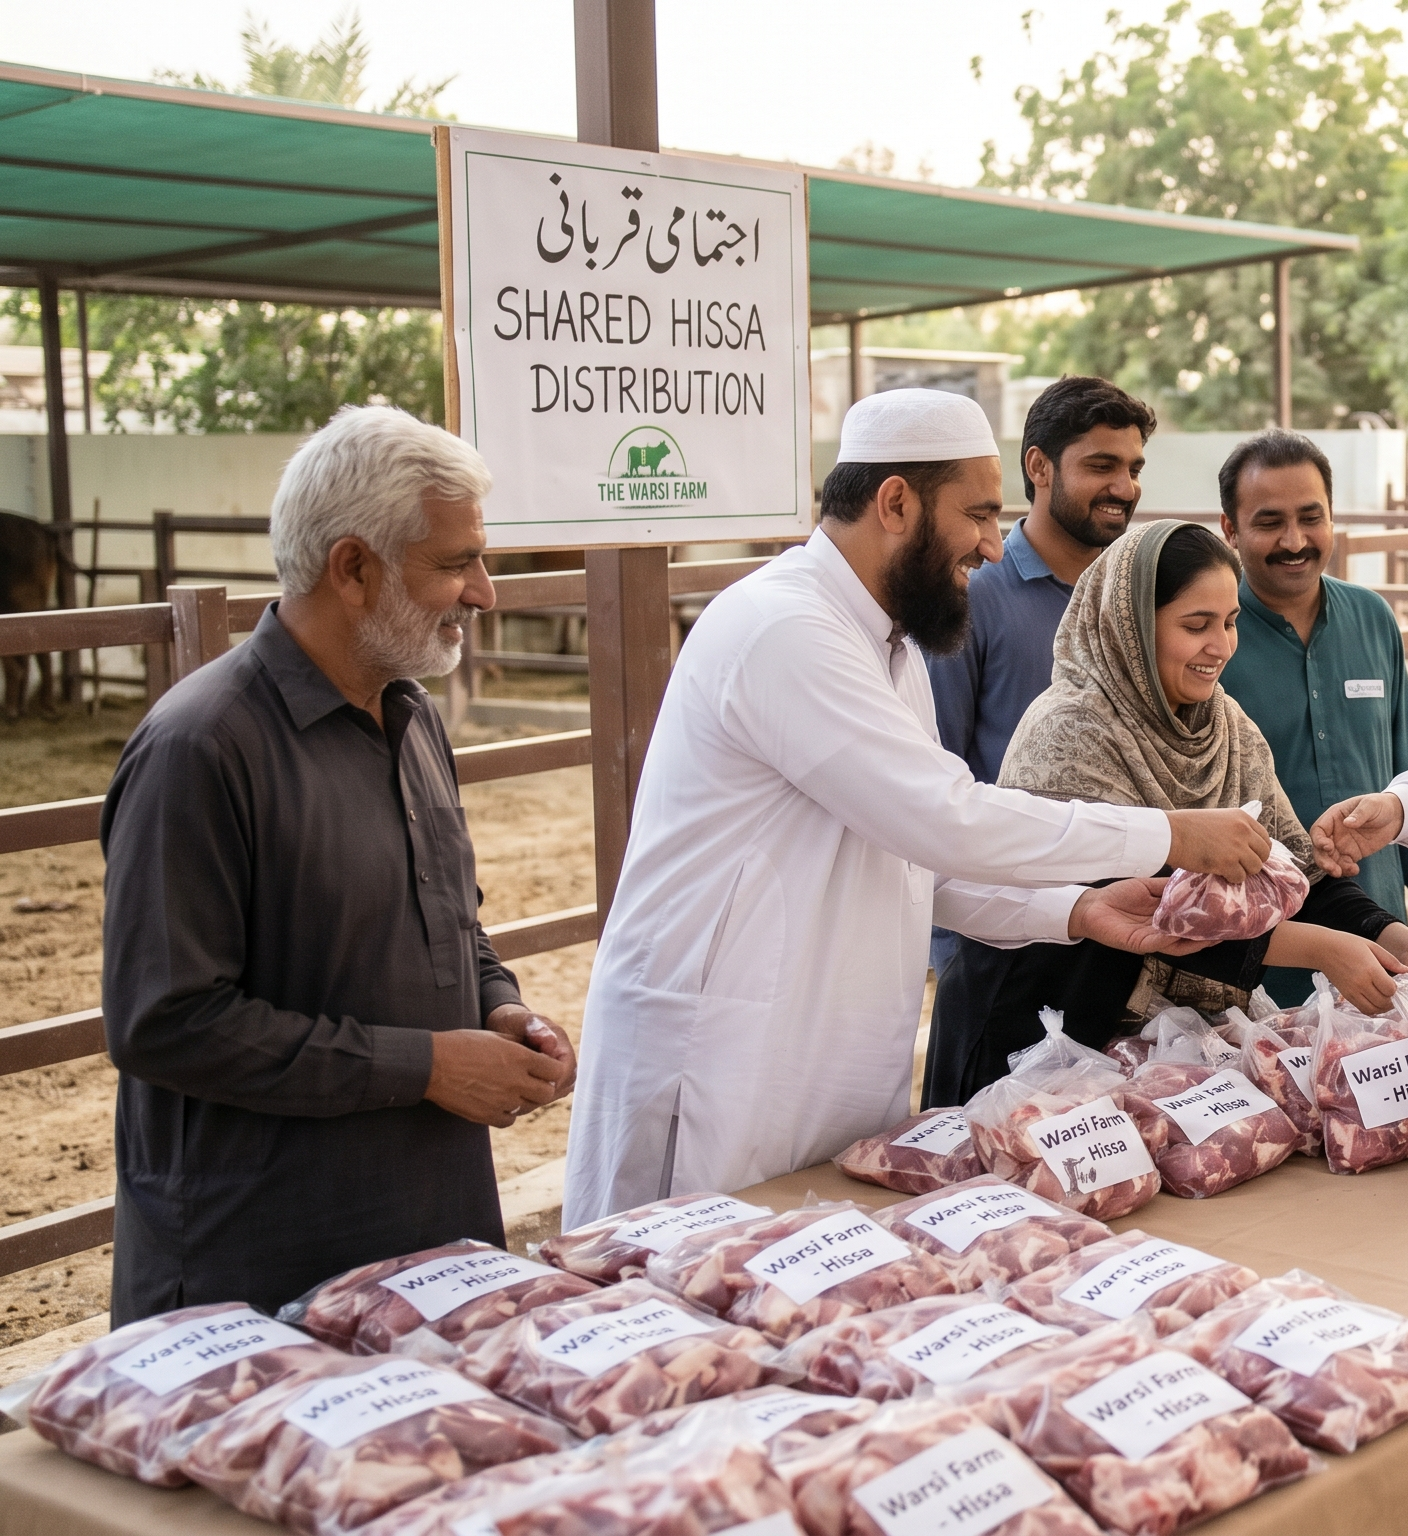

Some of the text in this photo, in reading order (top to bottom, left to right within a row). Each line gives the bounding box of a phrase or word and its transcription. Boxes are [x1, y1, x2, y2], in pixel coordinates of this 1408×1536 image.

[537, 172, 643, 271] قربانی
[494, 285, 766, 351] SHARED HISSA
[530, 363, 764, 416] DISTRIBUTION
[598, 481, 708, 501] THE WARSI FARM
[1352, 1057, 1402, 1085] Warsi
[1039, 1114, 1126, 1149] Warsi Farm
[1088, 1140, 1128, 1161] Hissa
[922, 1191, 1025, 1226] Warsi Farm
[976, 1204, 1026, 1221] Hissa
[763, 1222, 873, 1275] Warsi Farm
[820, 1247, 874, 1273] Hissa
[400, 1254, 519, 1291] Warsi Farm
[461, 1267, 520, 1288] Hissa
[1080, 1247, 1178, 1301] Warsi Farm
[1134, 1261, 1186, 1285] Hissa
[616, 1308, 674, 1327] Farm
[131, 1317, 271, 1370] Warsi Farm
[195, 1333, 266, 1361] Hissa
[907, 1311, 1019, 1362] Warsi Farm
[968, 1326, 1025, 1351] Hissa
[302, 1382, 377, 1420] Warsi
[370, 1387, 440, 1412] Hissa
[1088, 1366, 1204, 1422] Warsi Farm
[1153, 1391, 1210, 1421] Hissa
[878, 1448, 1004, 1518] Warsi Farm
[948, 1482, 1013, 1522] Hissa
